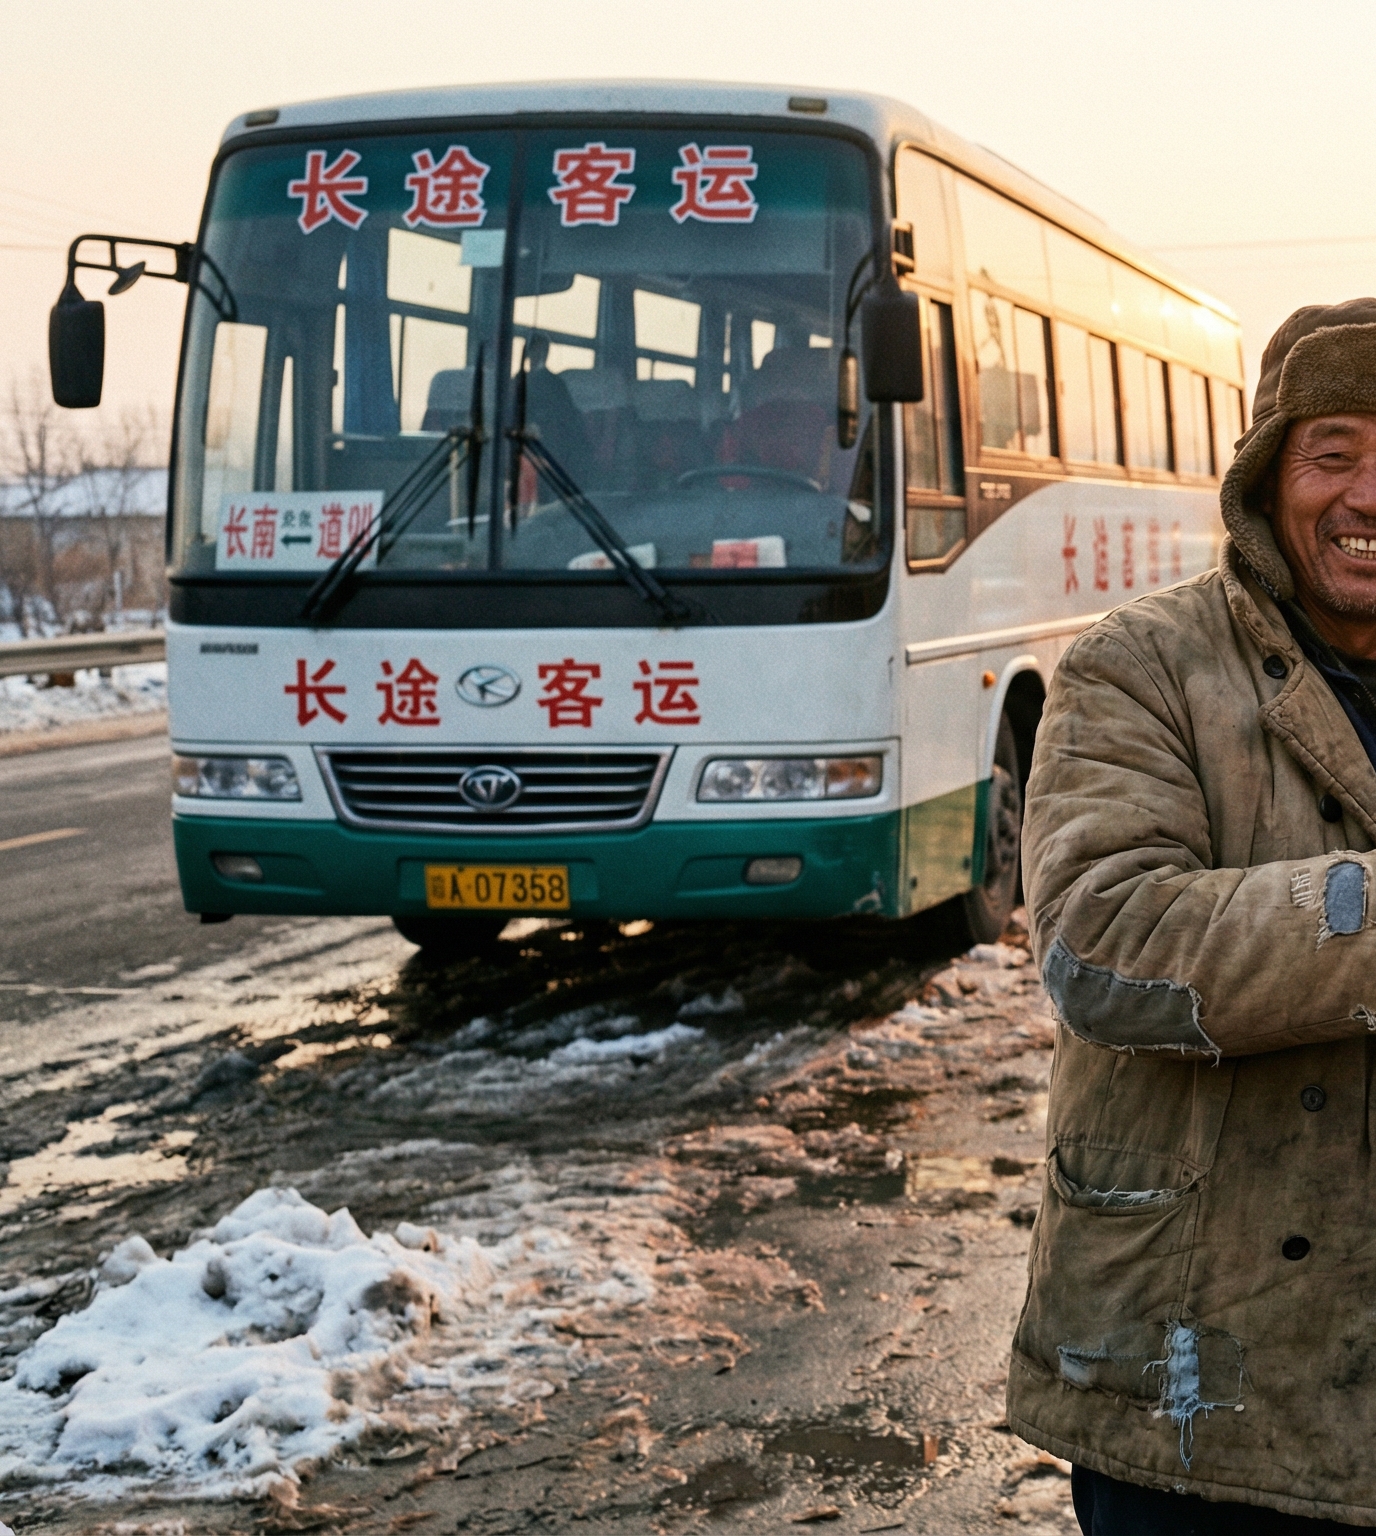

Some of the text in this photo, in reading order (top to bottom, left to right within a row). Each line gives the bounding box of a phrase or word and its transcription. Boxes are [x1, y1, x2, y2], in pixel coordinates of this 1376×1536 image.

[289, 143, 757, 234] 长途客运
[284, 658, 701, 728] 长途客运
